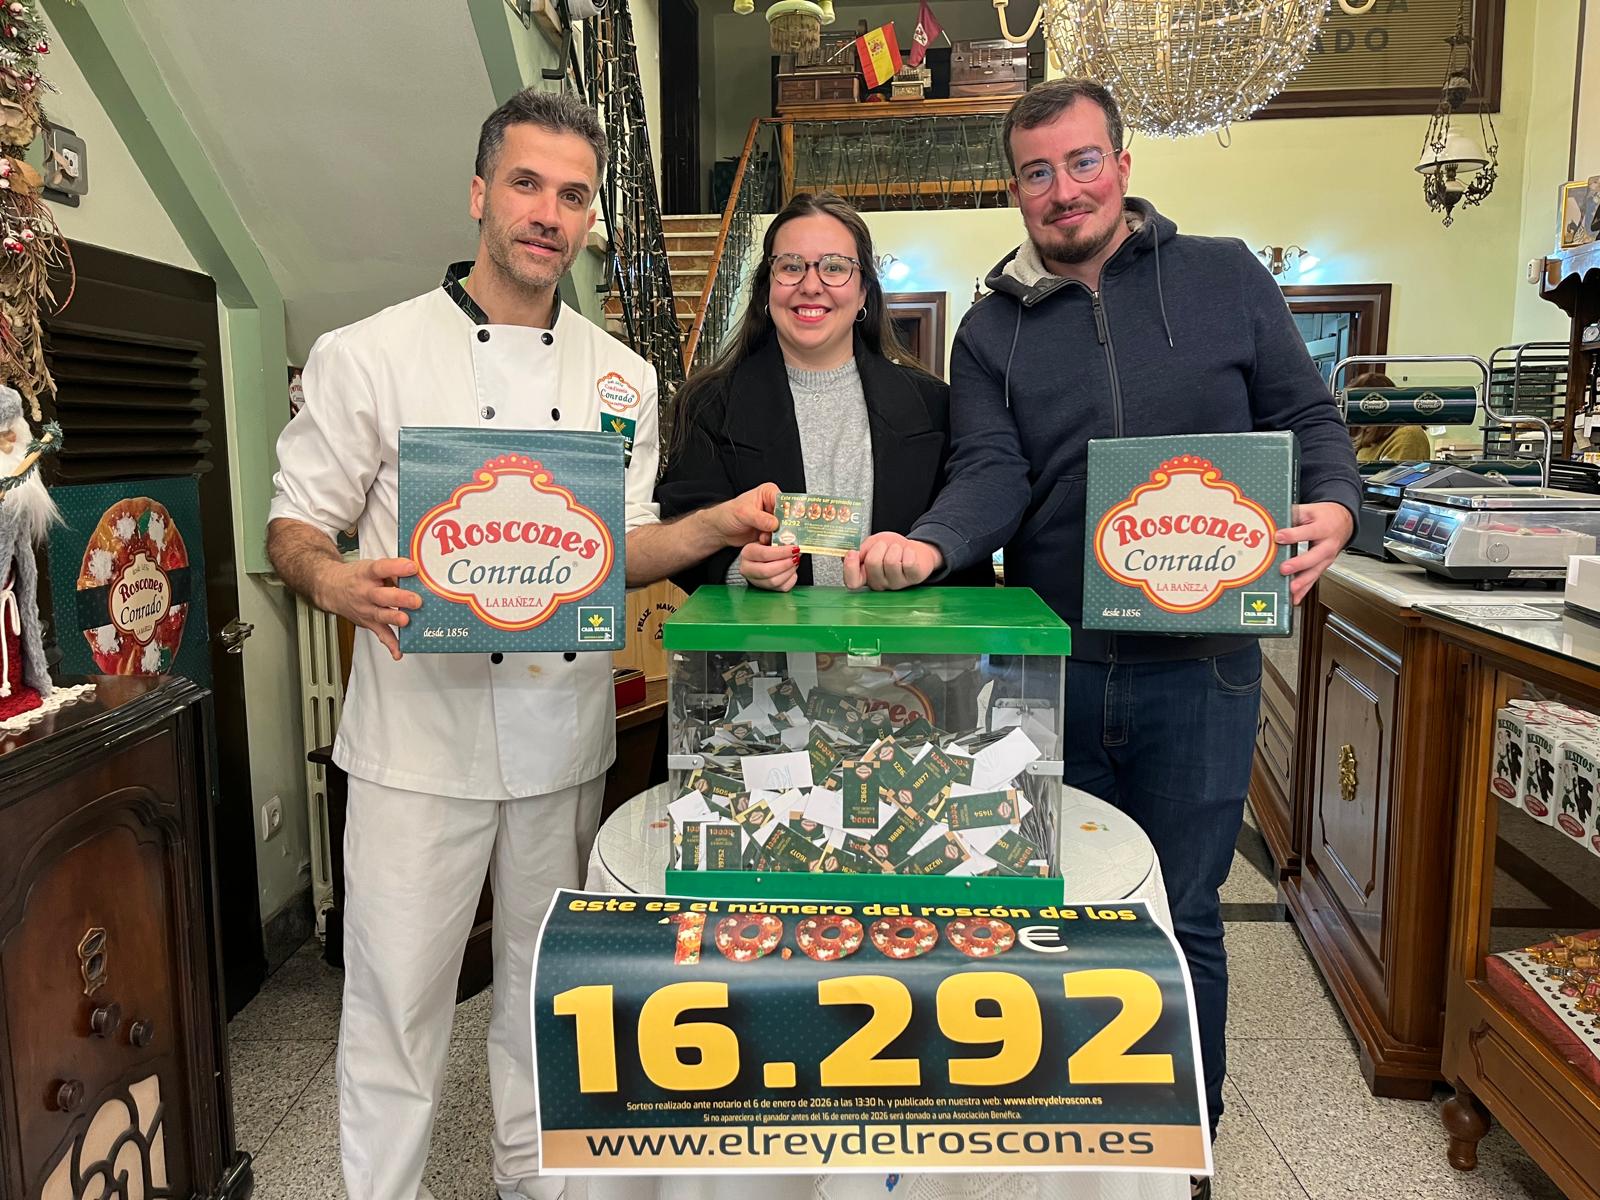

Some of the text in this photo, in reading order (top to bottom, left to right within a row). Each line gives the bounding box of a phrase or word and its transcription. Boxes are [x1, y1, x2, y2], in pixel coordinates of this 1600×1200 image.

[600, 388, 634, 404] Conrado
[431, 519, 601, 560] Roscones
[1112, 514, 1266, 549] Roscones
[447, 555, 572, 585] Conrado
[1124, 545, 1237, 572] Conrado
[119, 577, 164, 604] Roscones
[1156, 582, 1209, 592] LA BAÑEZA
[120, 593, 162, 625] Conrado
[485, 594, 543, 608] LA BAÑEZA
[1102, 608, 1141, 618] desde 1856
[423, 627, 469, 638] desde 1856
[636, 608, 652, 633] FELIZ
[568, 898, 1138, 922] este es el número del roscón de los
[553, 968, 1175, 1094] 16.292
[626, 1101, 653, 1111] Sorteo
[655, 1100, 691, 1111] realizado
[693, 1100, 711, 1110] ante
[713, 1099, 742, 1109] notario
[743, 1099, 751, 1109] el
[753, 1099, 759, 1109] 6
[760, 1099, 771, 1109] de
[772, 1100, 796, 1109] enero
[798, 1098, 808, 1108] de
[809, 1098, 832, 1108] 2026
[833, 1099, 839, 1107] a
[840, 1097, 853, 1108] las
[877, 1096, 886, 1107] h.
[887, 1098, 893, 1109] y
[894, 1096, 935, 1108] publicado
[936, 1098, 946, 1106] en
[948, 1097, 980, 1106] nuestra
[982, 1096, 1002, 1106] web:
[1003, 1095, 1103, 1108] www.elreydelroscon.es
[703, 1113, 710, 1122] Si
[711, 1114, 720, 1122] no
[720, 1113, 755, 1124] apareciera
[755, 1113, 762, 1122] el
[763, 1113, 789, 1123] ganador
[791, 1113, 809, 1122] antes
[810, 1112, 821, 1121] del
[822, 1112, 830, 1121] 16
[830, 1112, 839, 1121] de
[840, 1113, 859, 1121] enero
[860, 1112, 869, 1121] de
[870, 1111, 888, 1121] 2026
[889, 1111, 904, 1120] será
[905, 1110, 931, 1120] donado
[938, 1112, 951, 1120] una
[952, 1110, 989, 1120] Asociación
[990, 1109, 1022, 1120] Benéfica.
[585, 1125, 1154, 1164] www.elreydelroscon.es
